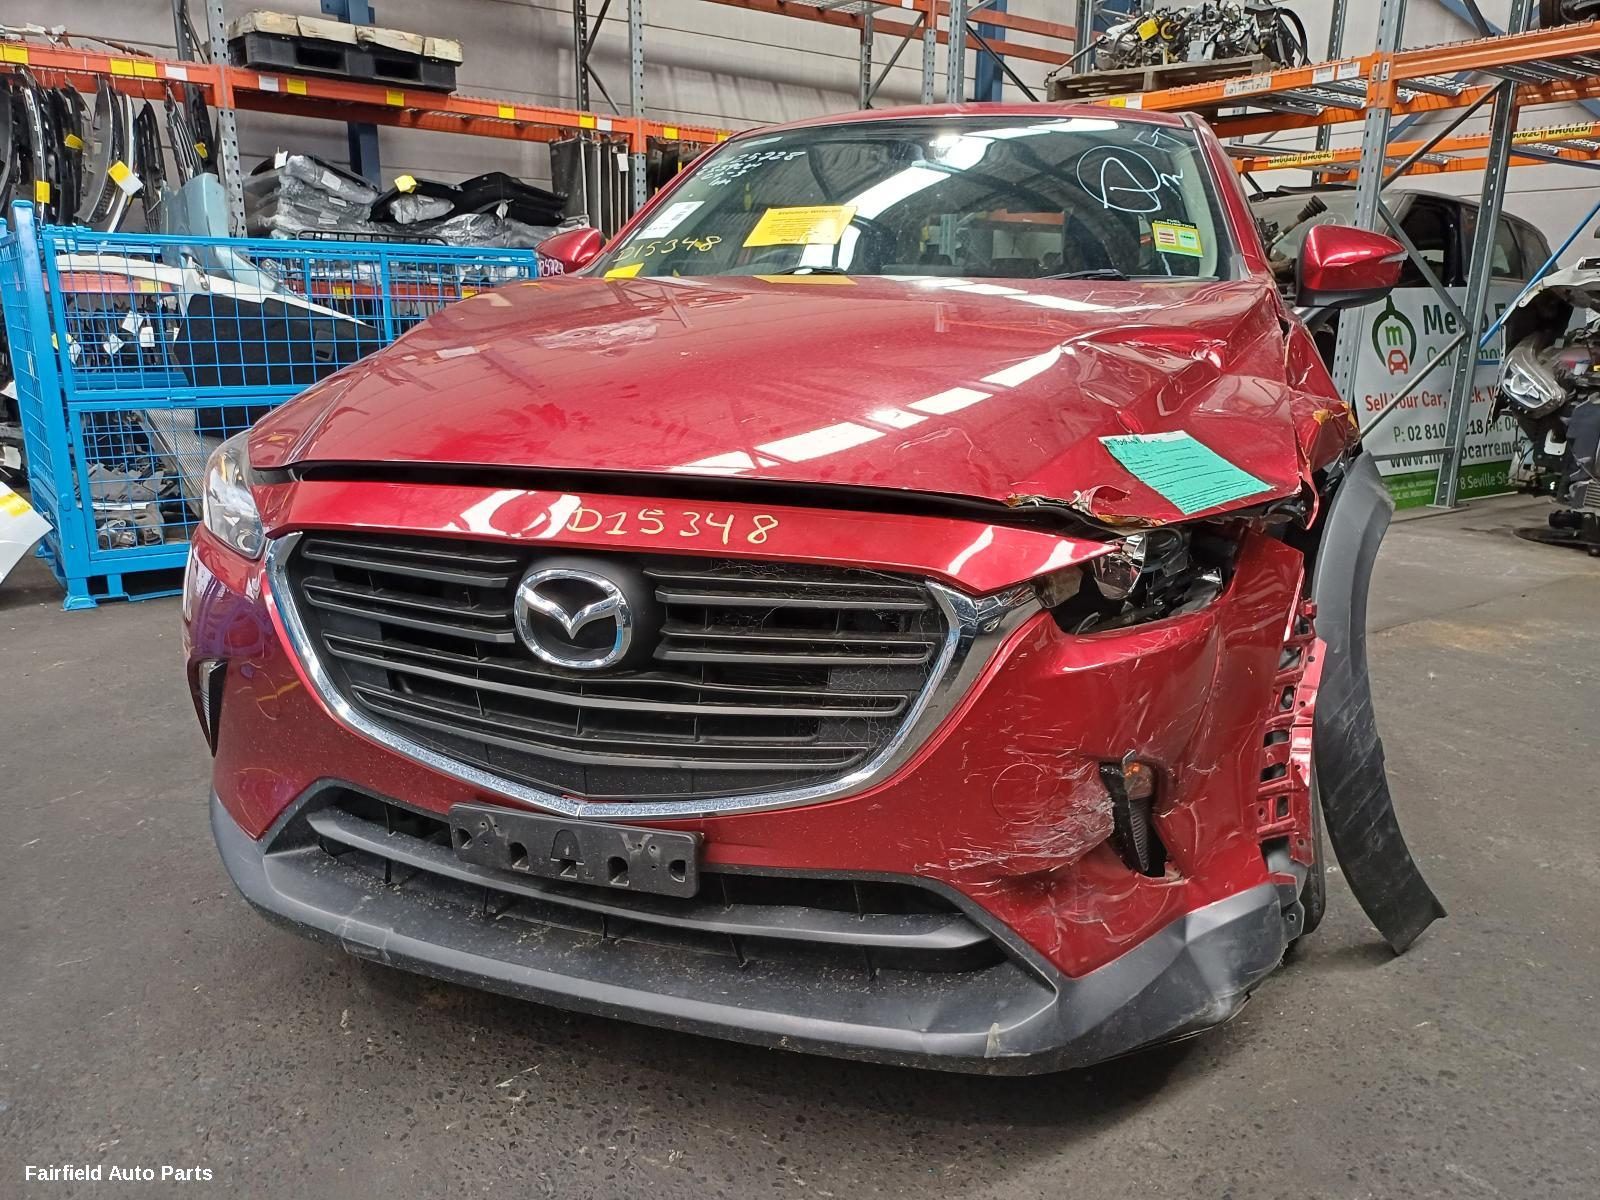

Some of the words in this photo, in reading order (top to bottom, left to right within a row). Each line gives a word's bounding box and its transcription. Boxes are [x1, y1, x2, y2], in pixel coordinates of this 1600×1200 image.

[612, 235, 722, 262] D15348
[1385, 325, 1404, 346] m
[1365, 392, 1388, 412] Sell
[1421, 390, 1448, 410] Car,
[1394, 424, 1406, 444] P:
[1407, 422, 1423, 442] 02
[1425, 422, 1446, 440] 810
[1467, 473, 1495, 490] Seville
[566, 505, 779, 545] D15348
